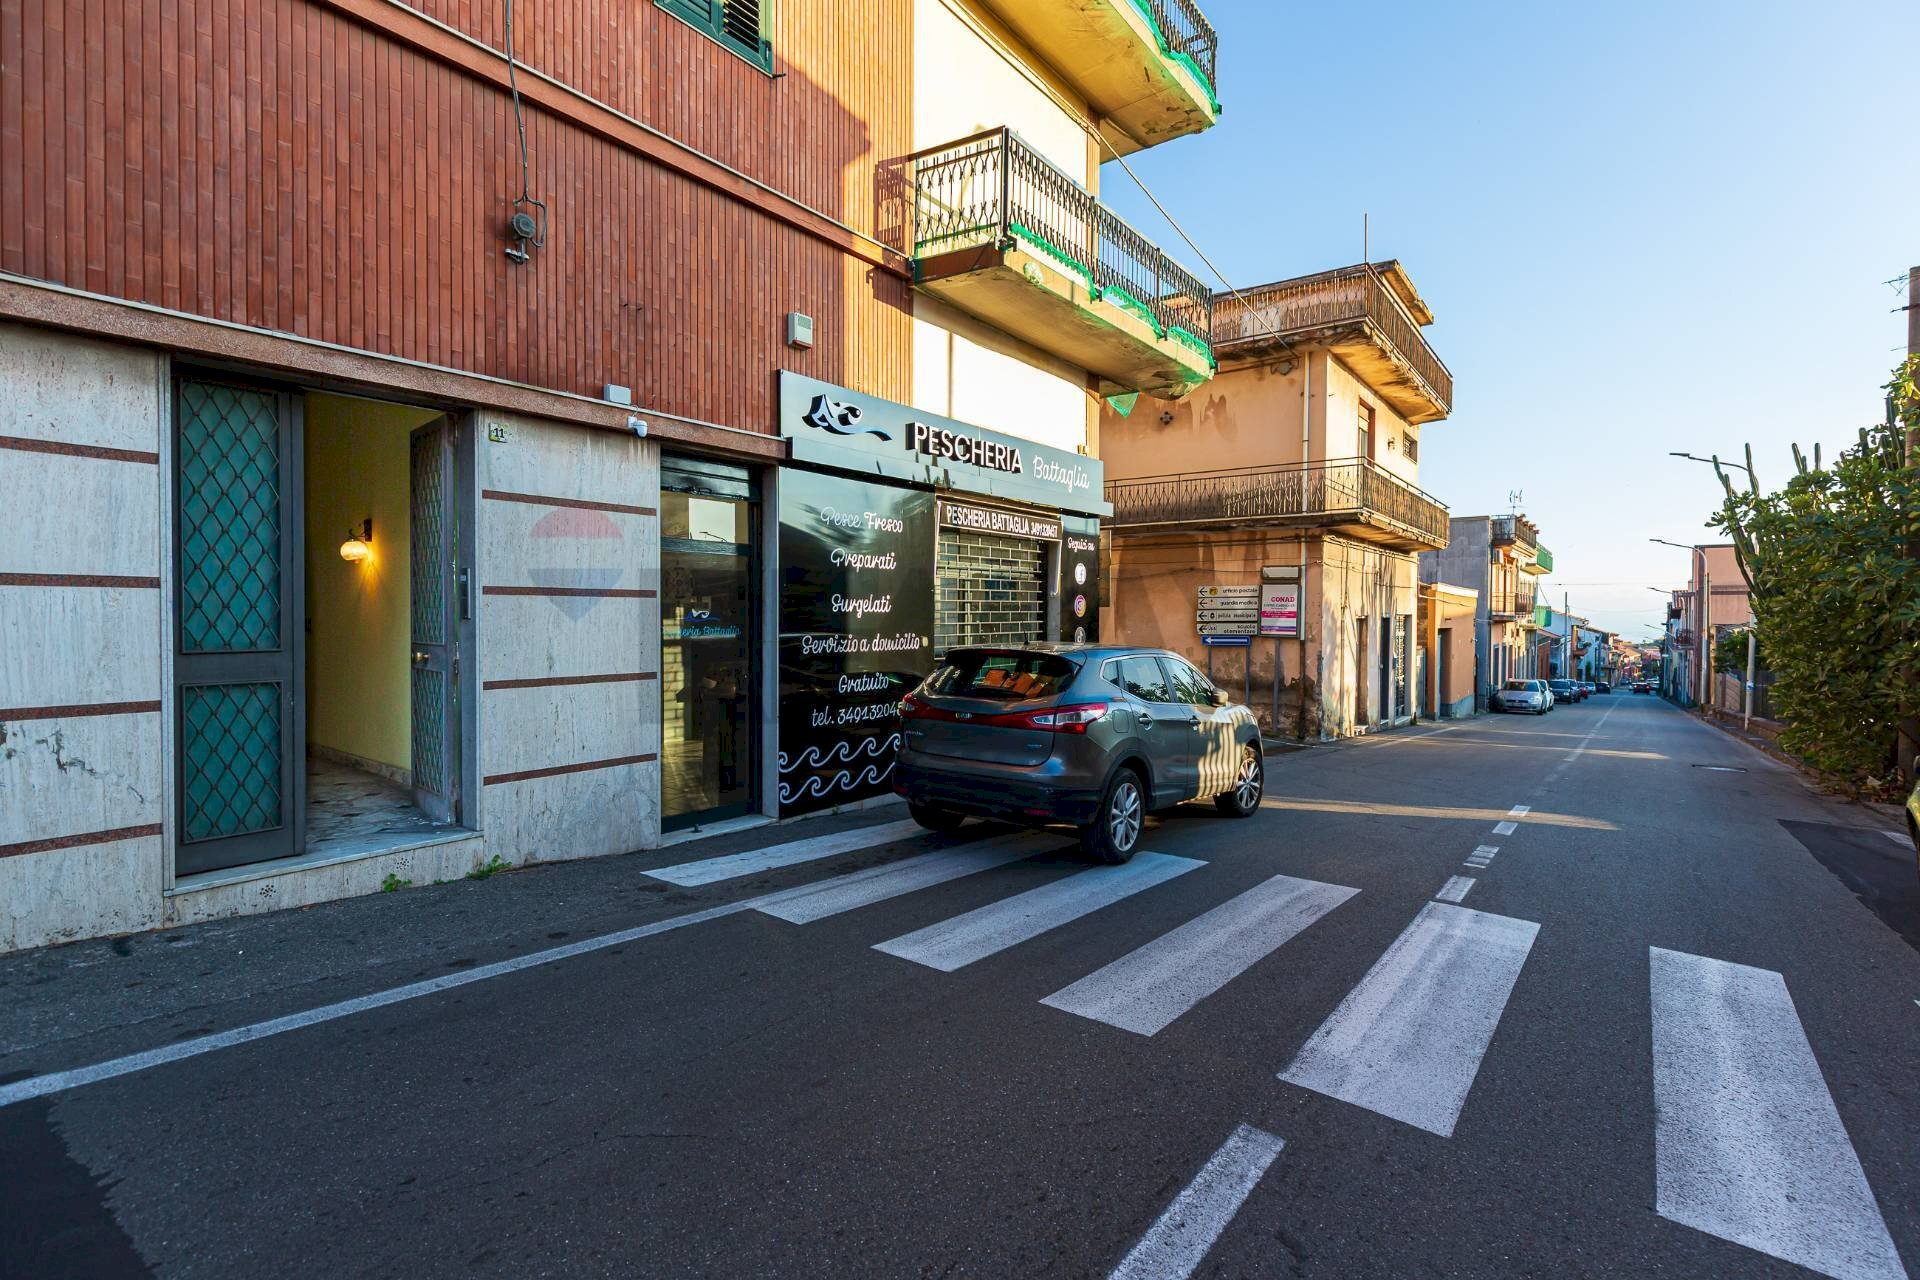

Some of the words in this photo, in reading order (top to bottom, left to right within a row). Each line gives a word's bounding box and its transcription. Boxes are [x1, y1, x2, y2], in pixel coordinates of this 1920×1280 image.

[494, 428, 504, 438] 11
[908, 422, 1024, 473] PESCHERIA
[1032, 455, 1090, 493] Battaglia
[820, 506, 862, 527] Pesce
[864, 512, 903, 533] Fresco
[946, 505, 990, 528] PESCHERIA
[991, 514, 1029, 535] BATTAGLIA
[1067, 537, 1087, 553] Seguici
[830, 548, 896, 573] Preparati
[831, 593, 891, 618] Surgelati
[802, 633, 858, 655] Servizio
[859, 640, 870, 652] a
[872, 632, 920, 652] domicilio
[838, 672, 889, 694] Gratuito
[811, 705, 835, 727] tel.
